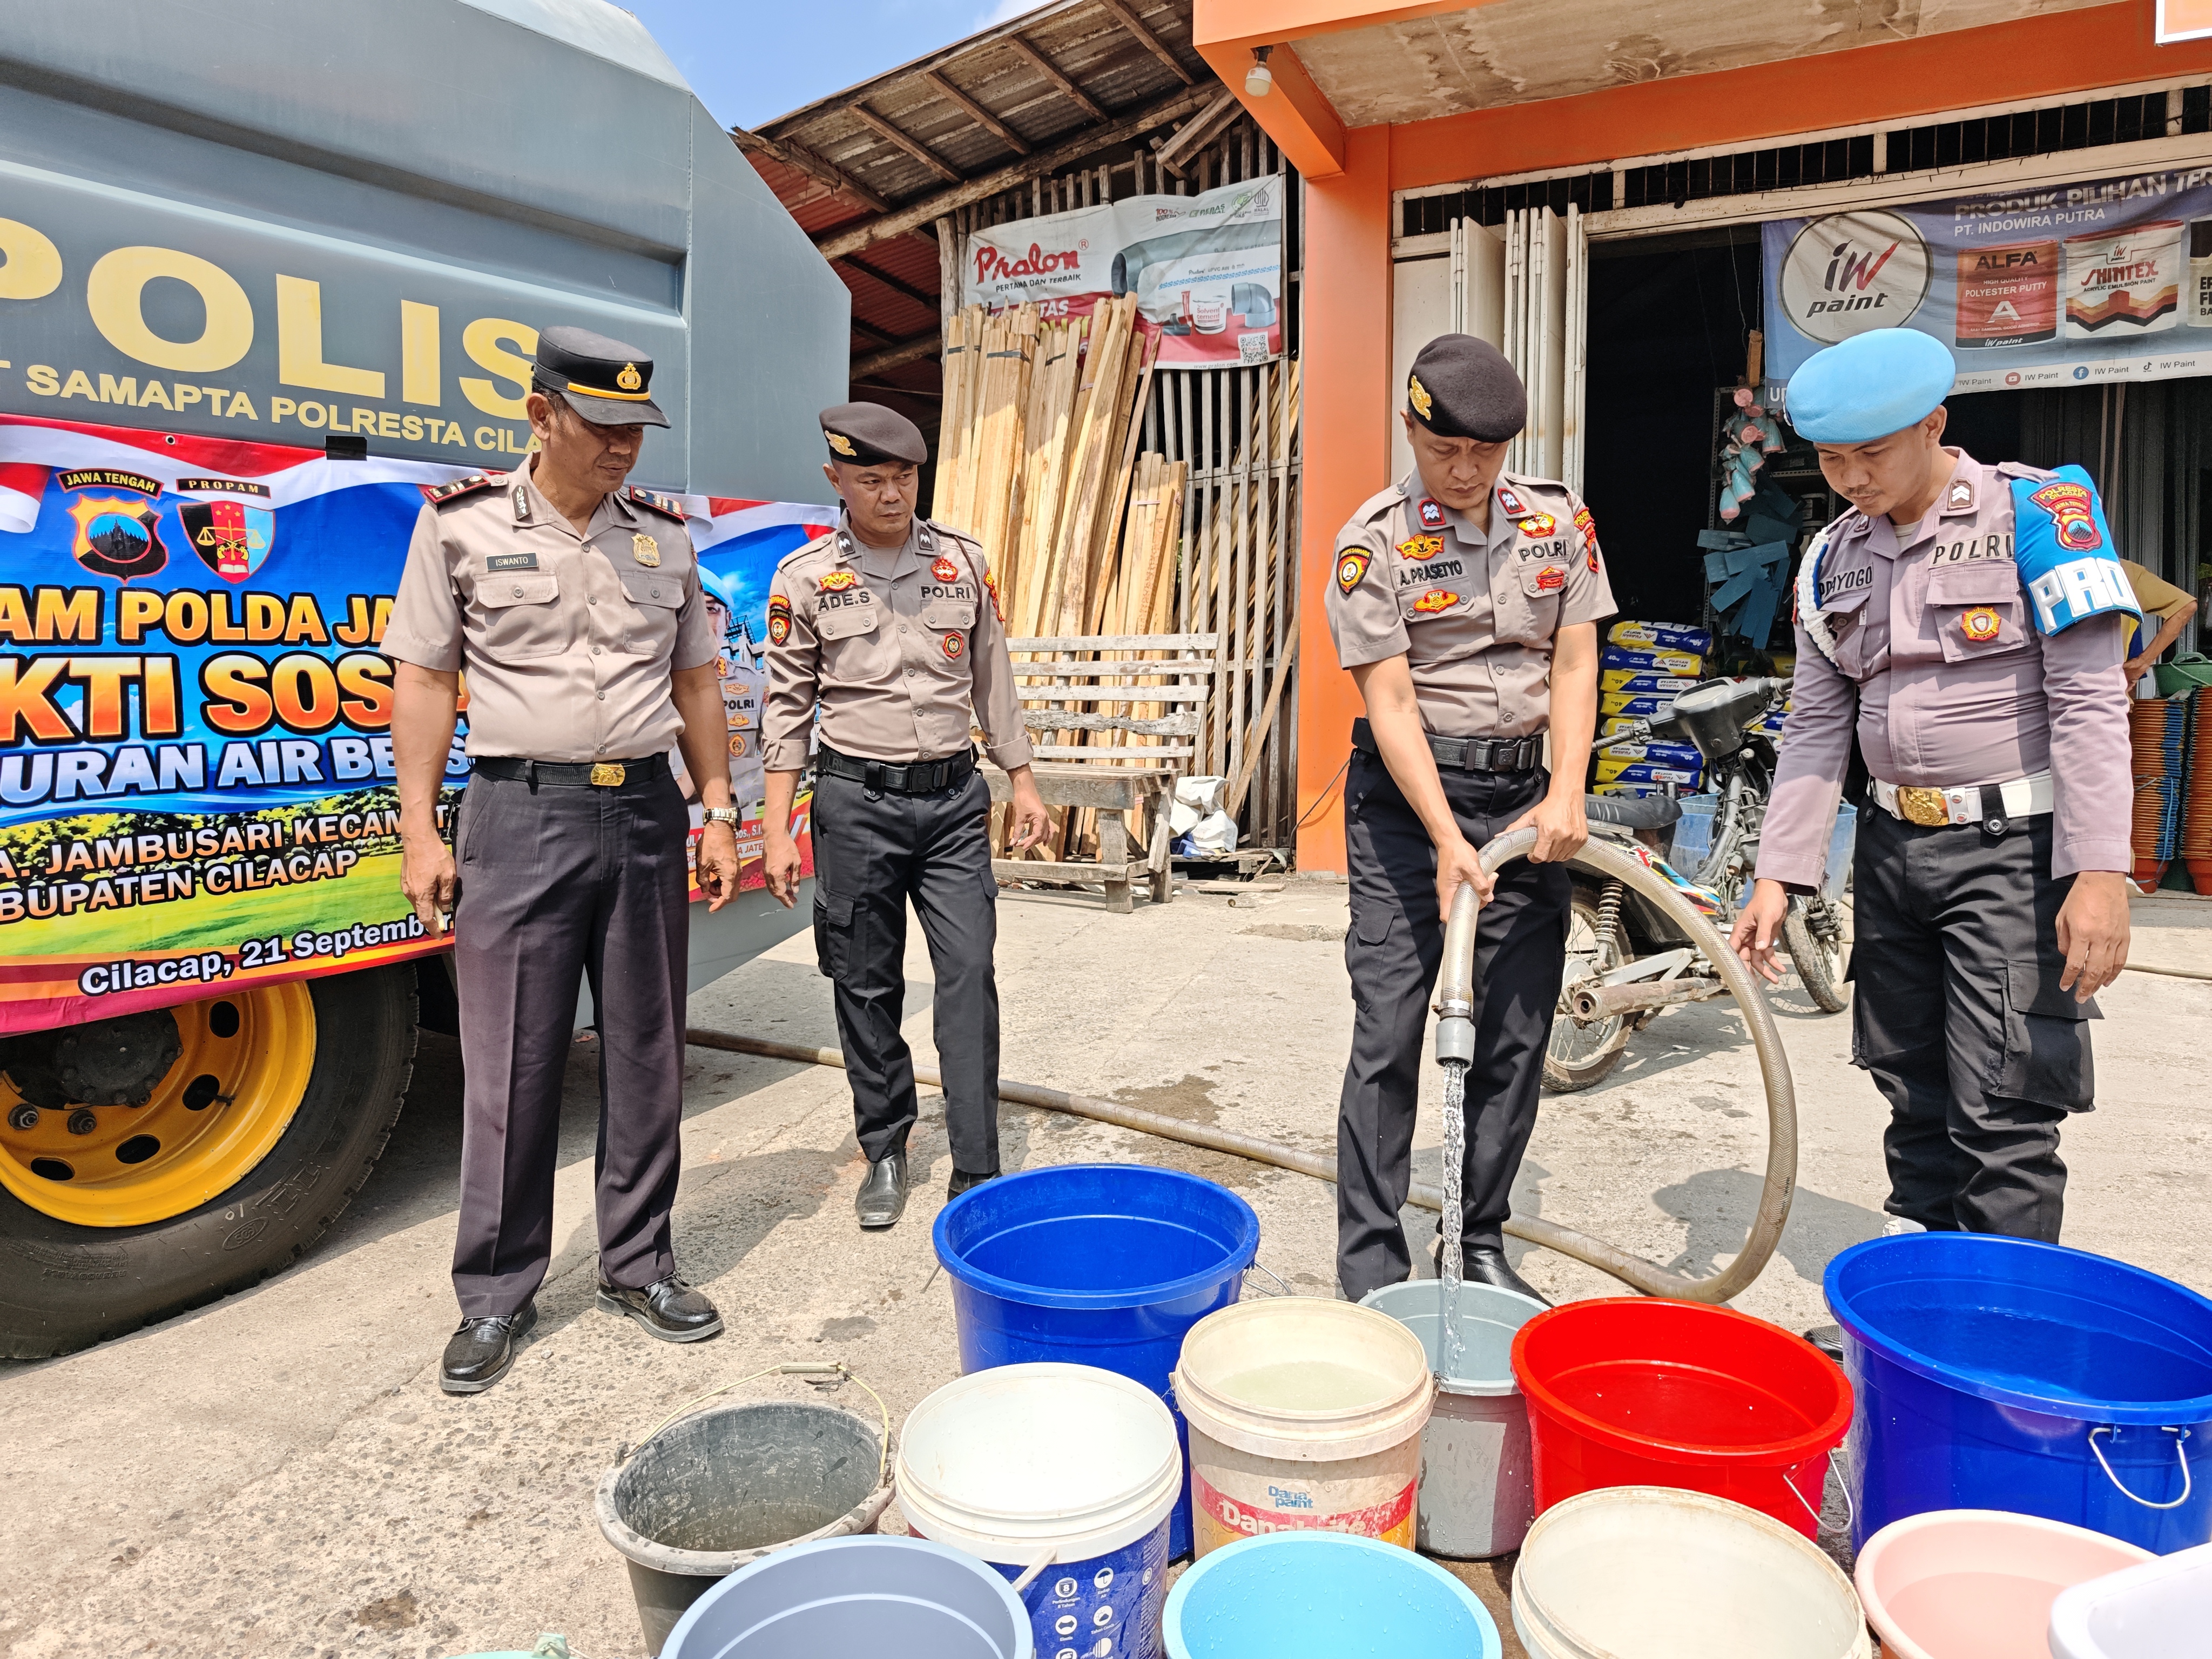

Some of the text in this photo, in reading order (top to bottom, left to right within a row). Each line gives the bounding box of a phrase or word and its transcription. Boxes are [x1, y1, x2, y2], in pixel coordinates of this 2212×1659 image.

[1955, 192, 2059, 221] PRODUK
[2067, 174, 2167, 207] PILIHAN
[1954, 208, 2105, 237] PT. INDOWIRA PUTRA
[973, 243, 1081, 286] Pralon
[1974, 251, 2038, 271] ALFA
[1029, 278, 1047, 287] DAN
[1049, 274, 1081, 284] TERBAIK
[2081, 260, 2159, 286] SHINTEX
[1965, 281, 2047, 297] POLYESTER PUTTY
[2108, 280, 2139, 290] EMULSION
[1806, 292, 1890, 319] paint
[2108, 366, 2129, 374] Paint
[2174, 360, 2195, 368] Paint
[1972, 377, 1992, 386] Paint
[2039, 372, 2059, 381] Paint
[26, 364, 259, 421] SAMAPTA
[272, 395, 467, 448] POLRESTA
[66, 472, 156, 493] JAWA TENGAH
[188, 480, 260, 494] PROPAM
[2039, 485, 2087, 500] POLRESTA
[1518, 539, 1566, 562] POLRI
[1933, 533, 2013, 564] POLRI
[495, 556, 529, 567] ISWANTO
[1410, 559, 1463, 584] PRASETYO
[818, 591, 870, 612] ADE.S
[921, 586, 971, 599] POLRI
[121, 591, 327, 643] POLDA
[218, 740, 325, 786] AIR
[331, 736, 471, 780] BES
[45, 822, 282, 875] JAMBUSARI
[207, 849, 359, 891] CILACAP
[83, 913, 451, 995] Cilacap, 21 Septembr
[1268, 1485, 1307, 1500] Dana
[1275, 1497, 1313, 1509] paint
